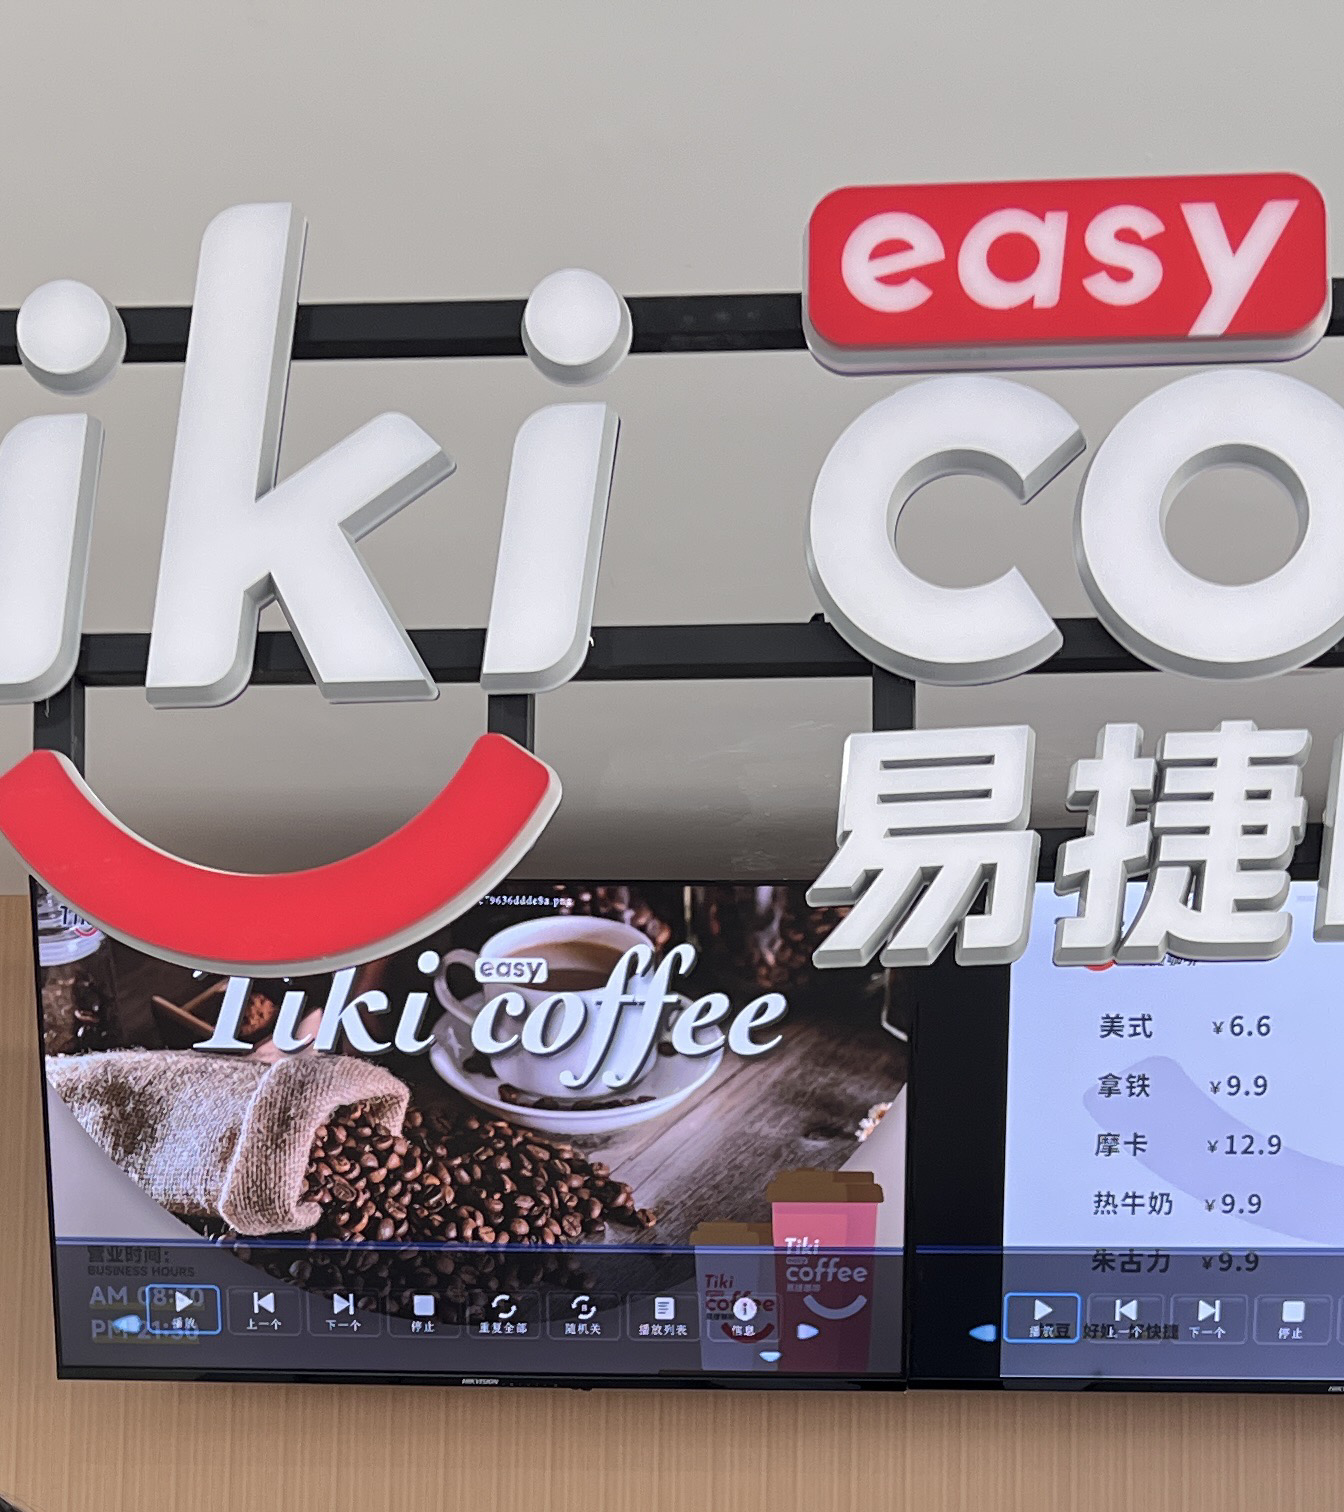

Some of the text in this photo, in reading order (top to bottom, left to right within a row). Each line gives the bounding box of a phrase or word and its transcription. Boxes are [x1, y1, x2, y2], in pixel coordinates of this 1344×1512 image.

[838, 172, 1310, 341] easy
[479, 960, 543, 983] easy
[192, 943, 789, 1090] Tiki coffee
[1098, 1013, 1154, 1039] 美式
[1097, 1073, 1151, 1098] 拿铁
[1094, 1132, 1148, 1157] 摩卡
[1092, 1191, 1174, 1216] 热牛奶
[785, 1236, 820, 1255] Tiki
[786, 1257, 868, 1283] coffee
[1091, 1249, 1171, 1273] 朱古力
[87, 1266, 195, 1278] BUSINESS HOURS
[89, 1286, 205, 1306] AM 08:0
[705, 1291, 775, 1312] coe
[246, 1318, 282, 1331] 上一个
[325, 1319, 362, 1332] 下一个
[411, 1320, 435, 1333] 停止
[478, 1321, 529, 1335] 重复全部
[638, 1323, 688, 1336] 播放列表
[1106, 1326, 1142, 1338] 上一个
[1188, 1326, 1226, 1339] 下一个
[1278, 1327, 1303, 1340] 停止
